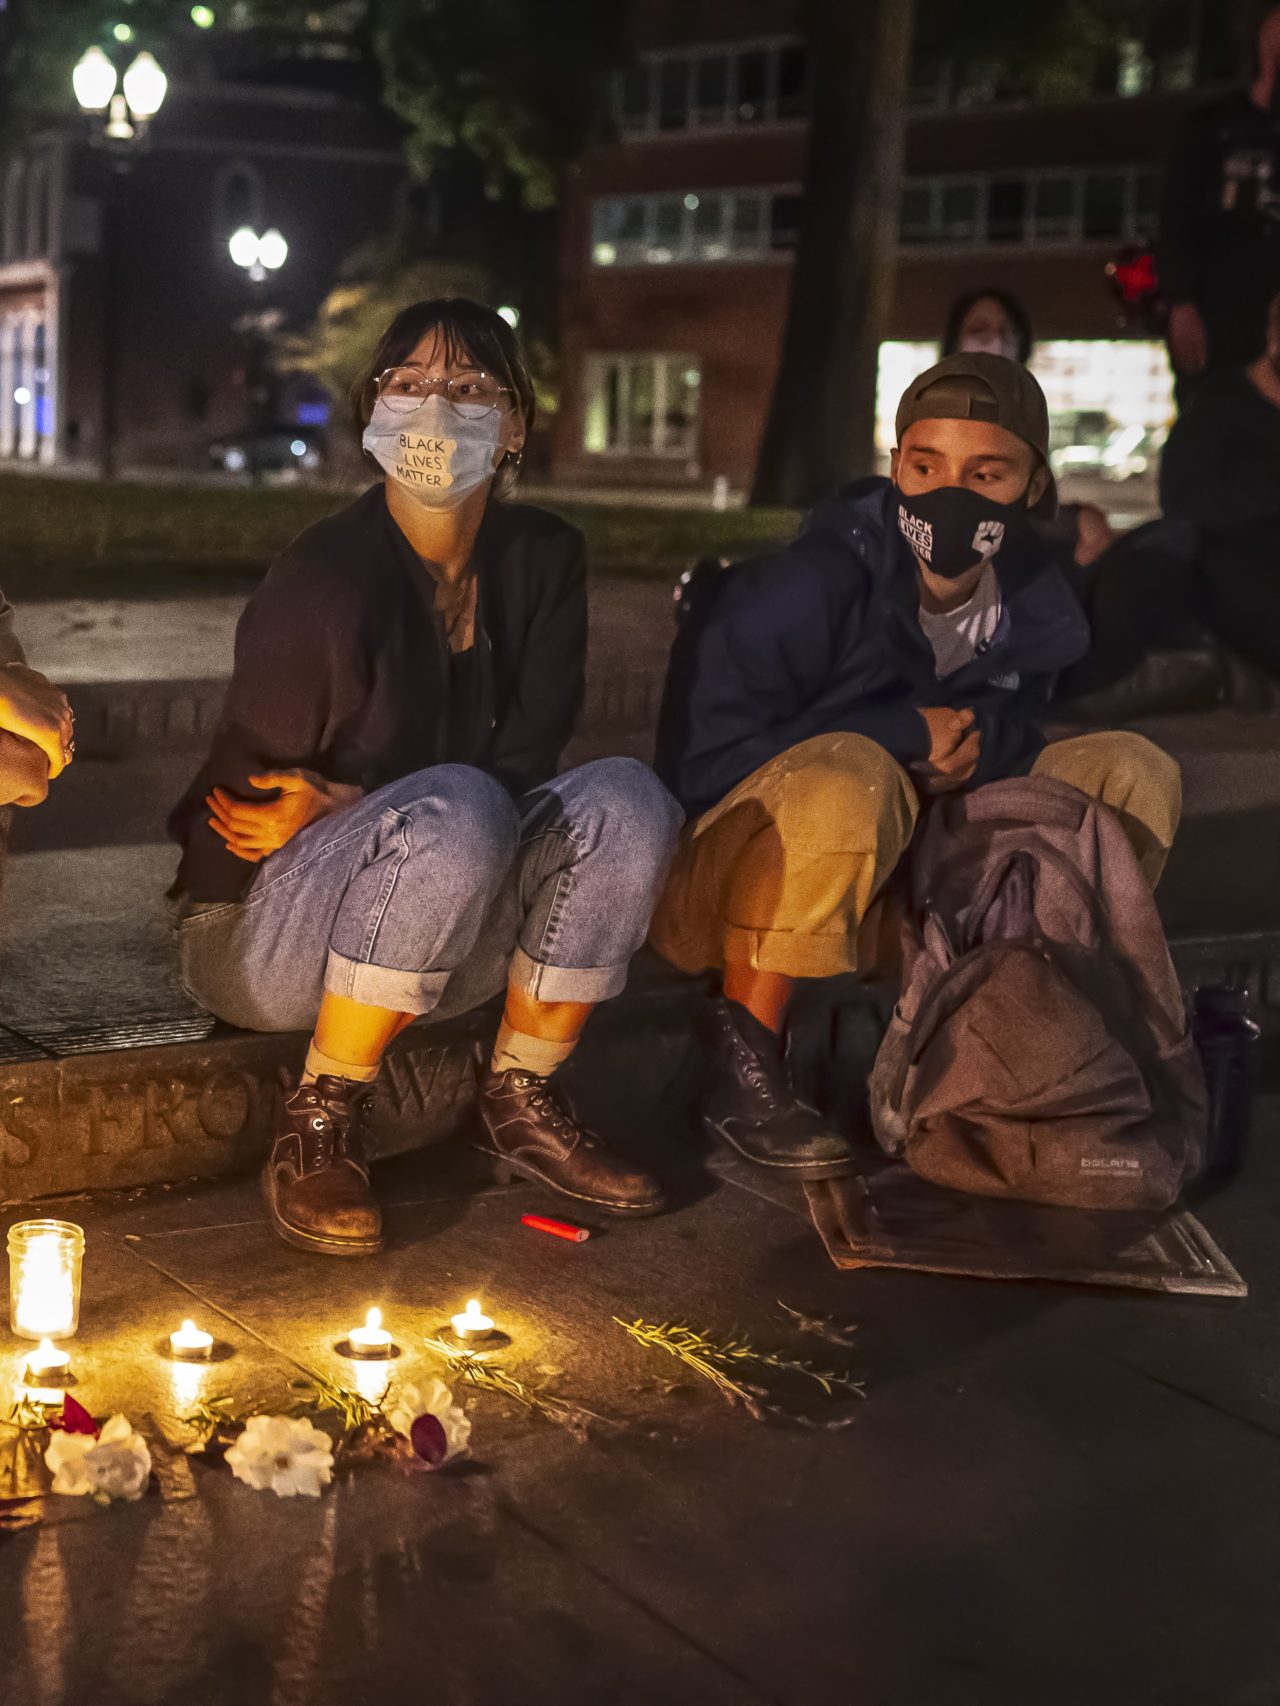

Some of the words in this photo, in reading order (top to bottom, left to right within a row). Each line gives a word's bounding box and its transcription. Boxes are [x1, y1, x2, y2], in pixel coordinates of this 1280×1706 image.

[399, 433, 445, 453] BLACK
[404, 454, 442, 470] LIVES
[396, 465, 442, 487] MATTER
[898, 504, 933, 535] BLACK
